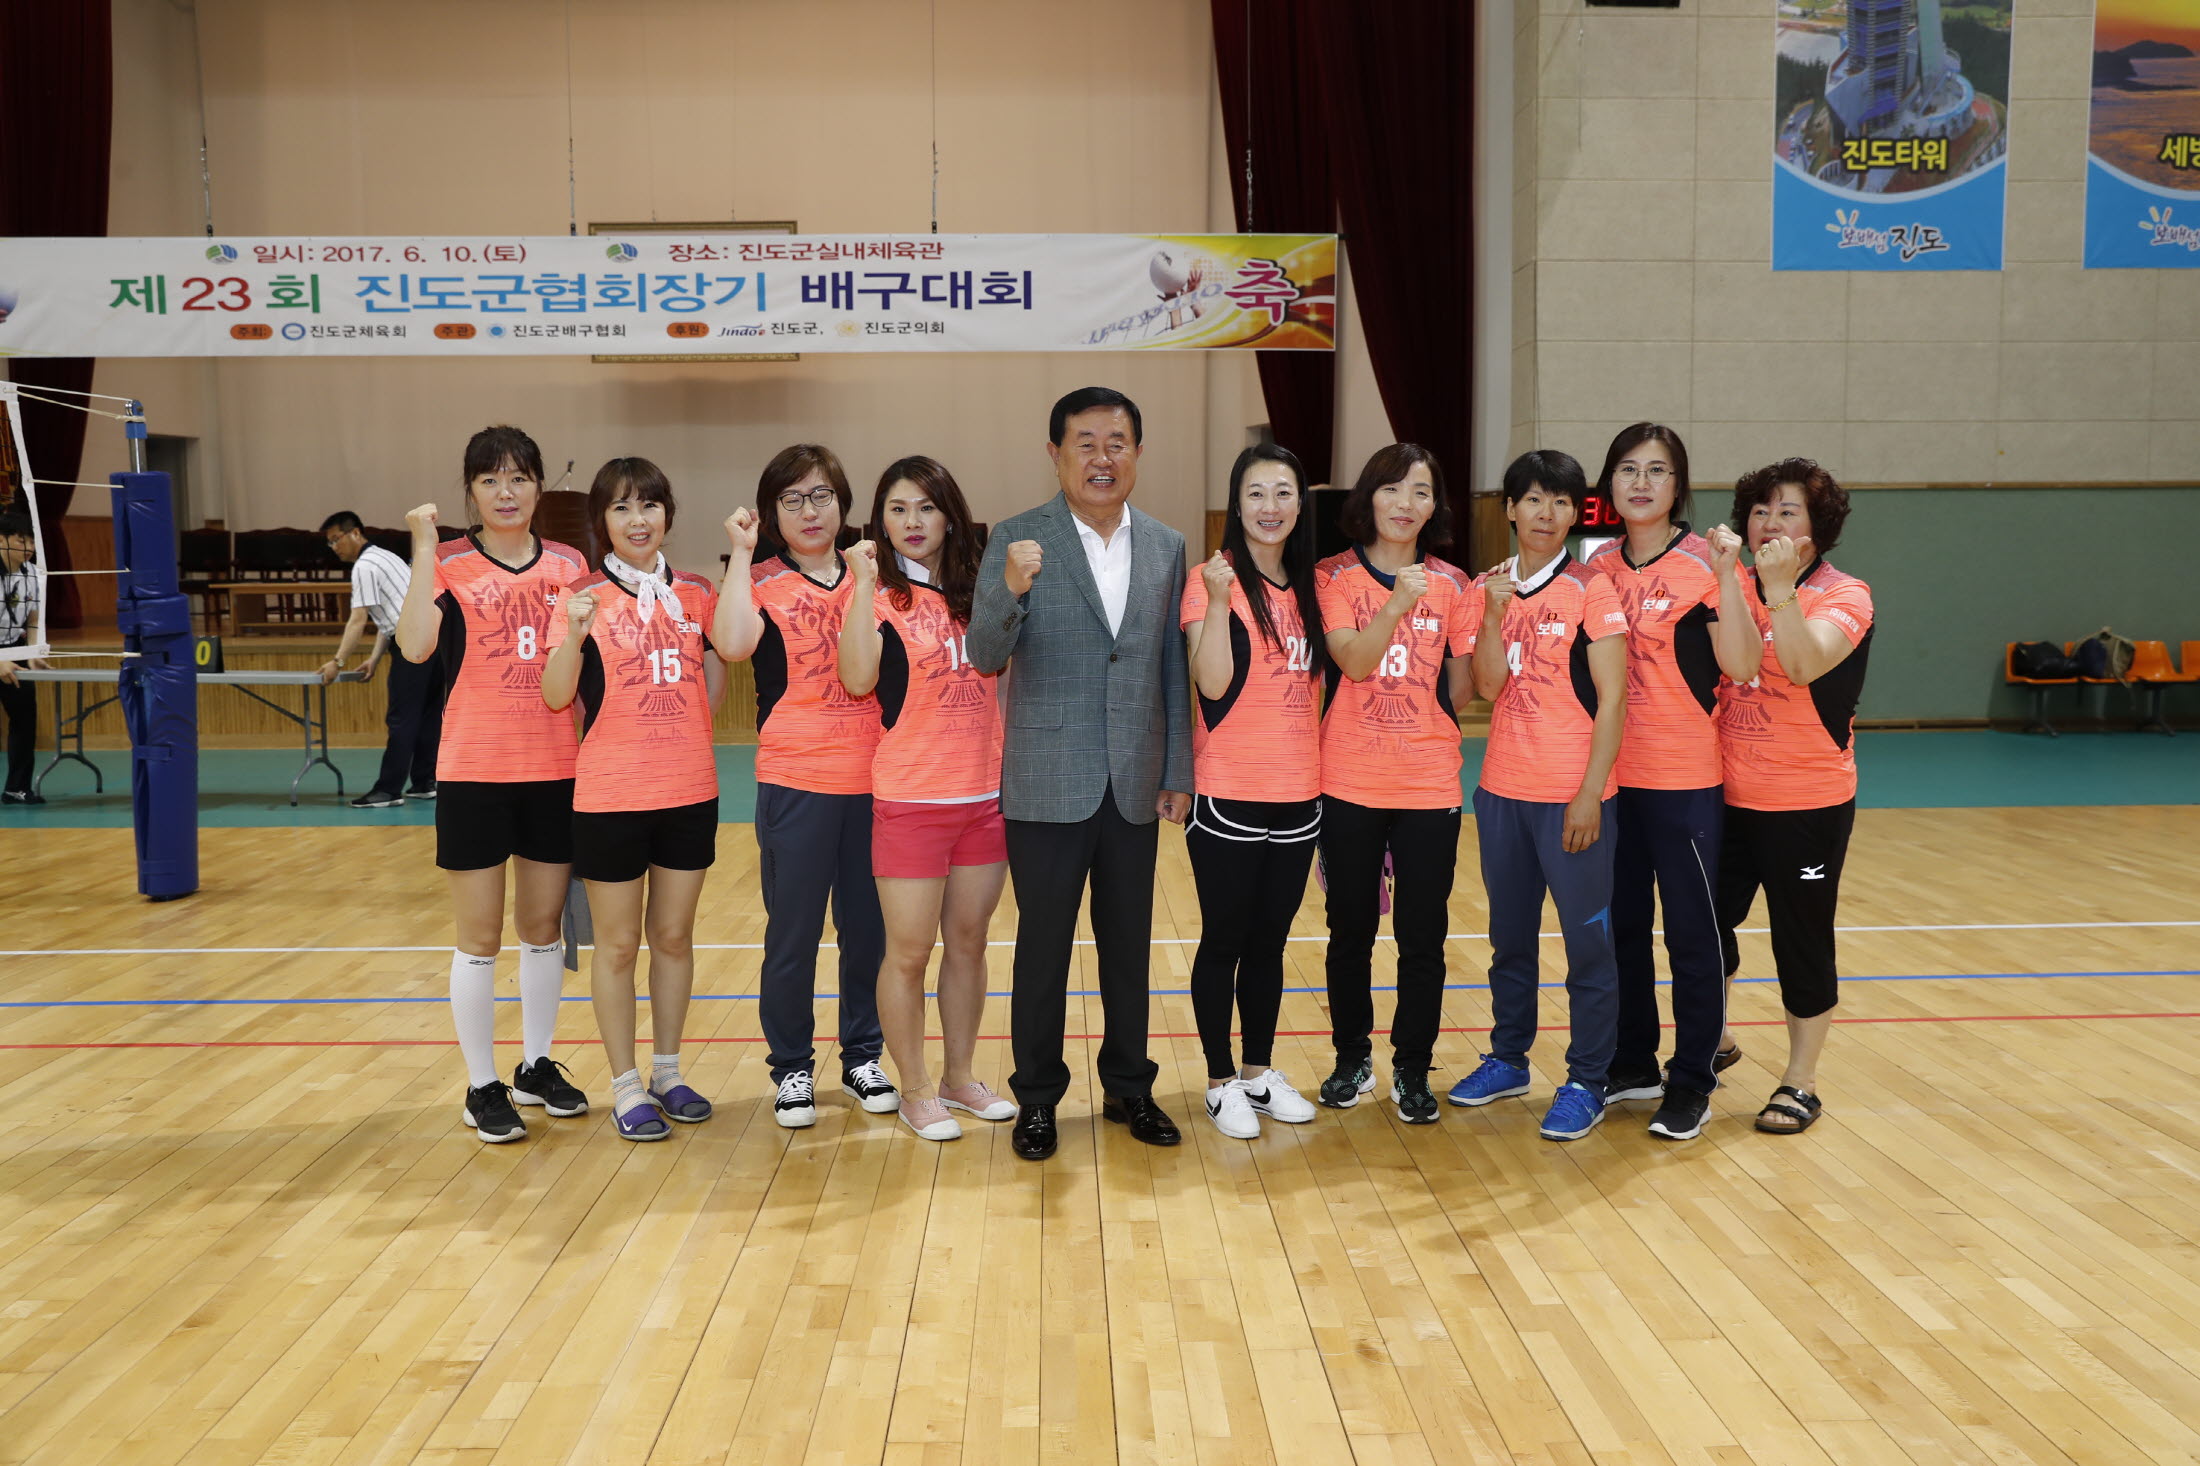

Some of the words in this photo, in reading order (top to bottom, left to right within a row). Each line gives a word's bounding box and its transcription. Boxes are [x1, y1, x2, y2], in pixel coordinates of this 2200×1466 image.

[1842, 138, 1948, 171] 진도타워
[668, 243, 729, 263] 장소:
[739, 241, 945, 262] 진도군실내체육관
[1890, 223, 1949, 260] 진도
[253, 244, 314, 264] 일시:
[322, 245, 391, 264] 2017.
[403, 245, 427, 264] 6.
[354, 271, 767, 314] 진도군협회장기
[801, 269, 1033, 311] 배구대회
[1226, 258, 1300, 326] 축
[310, 324, 407, 339] 진도군체육회
[513, 324, 626, 338] 진도군배구협회
[864, 321, 945, 335] 진도군의회
[1640, 599, 1672, 612] 보배
[1412, 616, 1439, 633] 보배
[1536, 622, 1566, 637] 보배
[195, 640, 211, 666] 0
[517, 625, 538, 661] 8
[647, 648, 683, 685] 15
